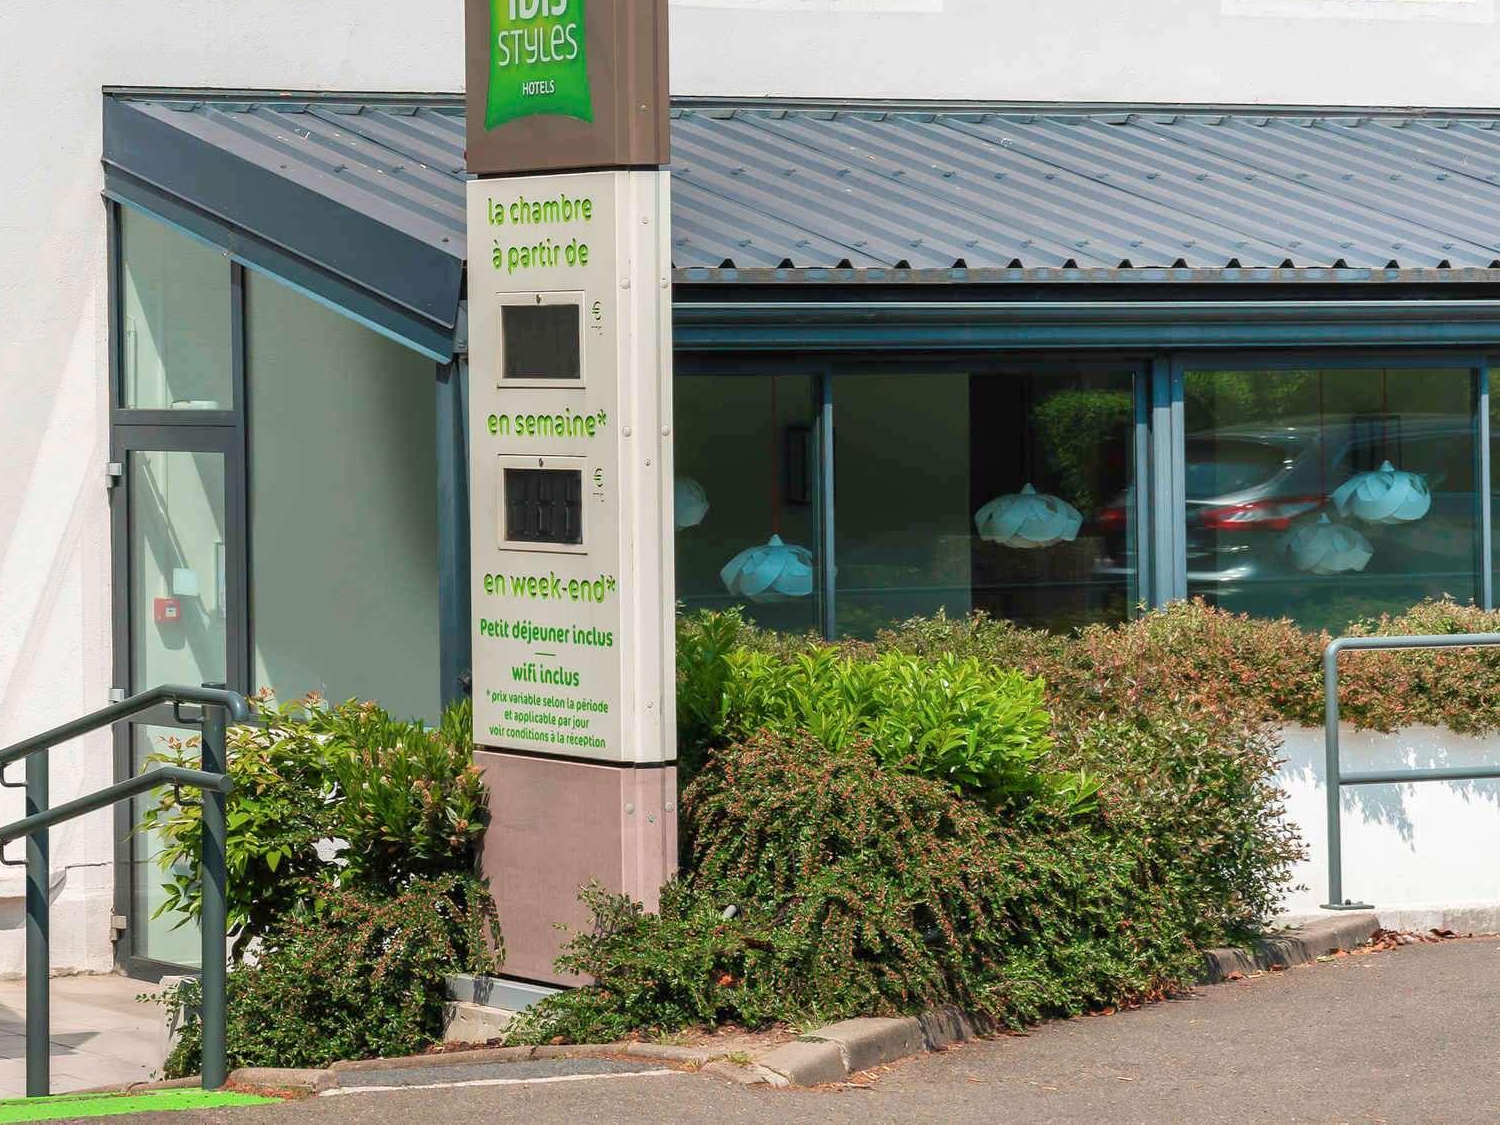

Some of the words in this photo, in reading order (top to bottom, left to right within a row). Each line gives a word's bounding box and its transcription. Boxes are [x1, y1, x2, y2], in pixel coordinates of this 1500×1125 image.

[522, 79, 554, 95] HOTELS
[488, 198, 504, 225] la
[510, 194, 592, 224] chambre
[492, 240, 502, 269] à
[508, 238, 560, 275] partir
[565, 238, 588, 267] de
[487, 413, 510, 436] en
[484, 572, 505, 595] en
[480, 618, 509, 638] Petit
[512, 620, 569, 644] déjeuner
[573, 625, 613, 647] inclus
[512, 663, 537, 683] wifi
[540, 665, 580, 686] inclus
[492, 691, 507, 704] prix
[509, 693, 541, 706] variable
[543, 697, 565, 708] selon
[567, 699, 574, 709] la
[576, 699, 608, 713] période
[504, 711, 512, 720] et
[514, 712, 556, 726] applicable
[558, 716, 571, 726] par
[572, 717, 589, 729] jour
[489, 725, 505, 737] voir
[507, 727, 549, 742] conditions
[557, 731, 565, 743] la
[566, 733, 605, 748] réception
